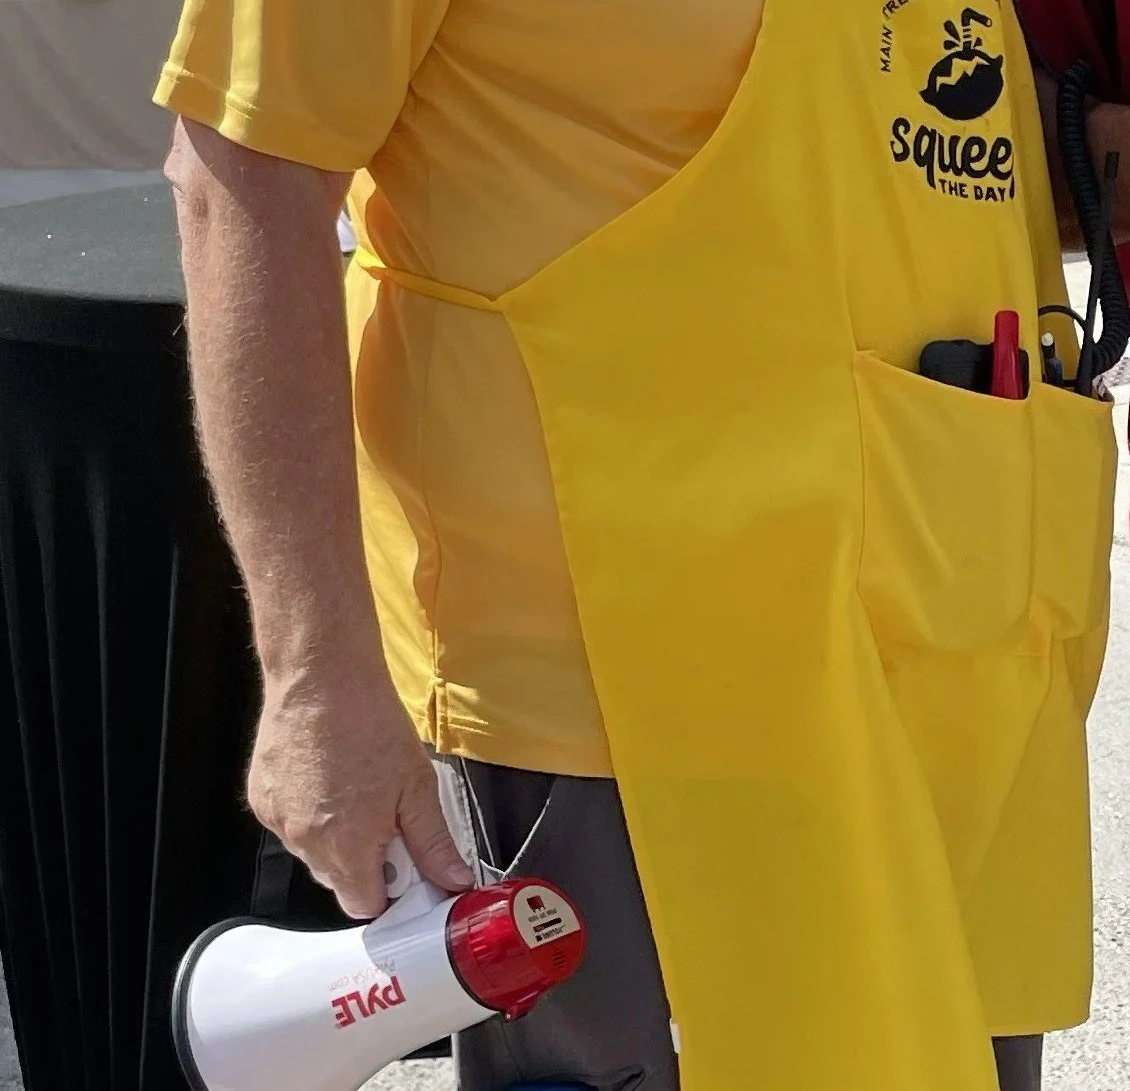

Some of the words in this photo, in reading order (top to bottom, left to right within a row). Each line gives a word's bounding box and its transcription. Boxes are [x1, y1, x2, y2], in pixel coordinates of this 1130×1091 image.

[880, 24, 893, 73] MAIN
[938, 178, 968, 199] THE
[973, 185, 1007, 202] DAY
[331, 976, 407, 1028] PYLE
